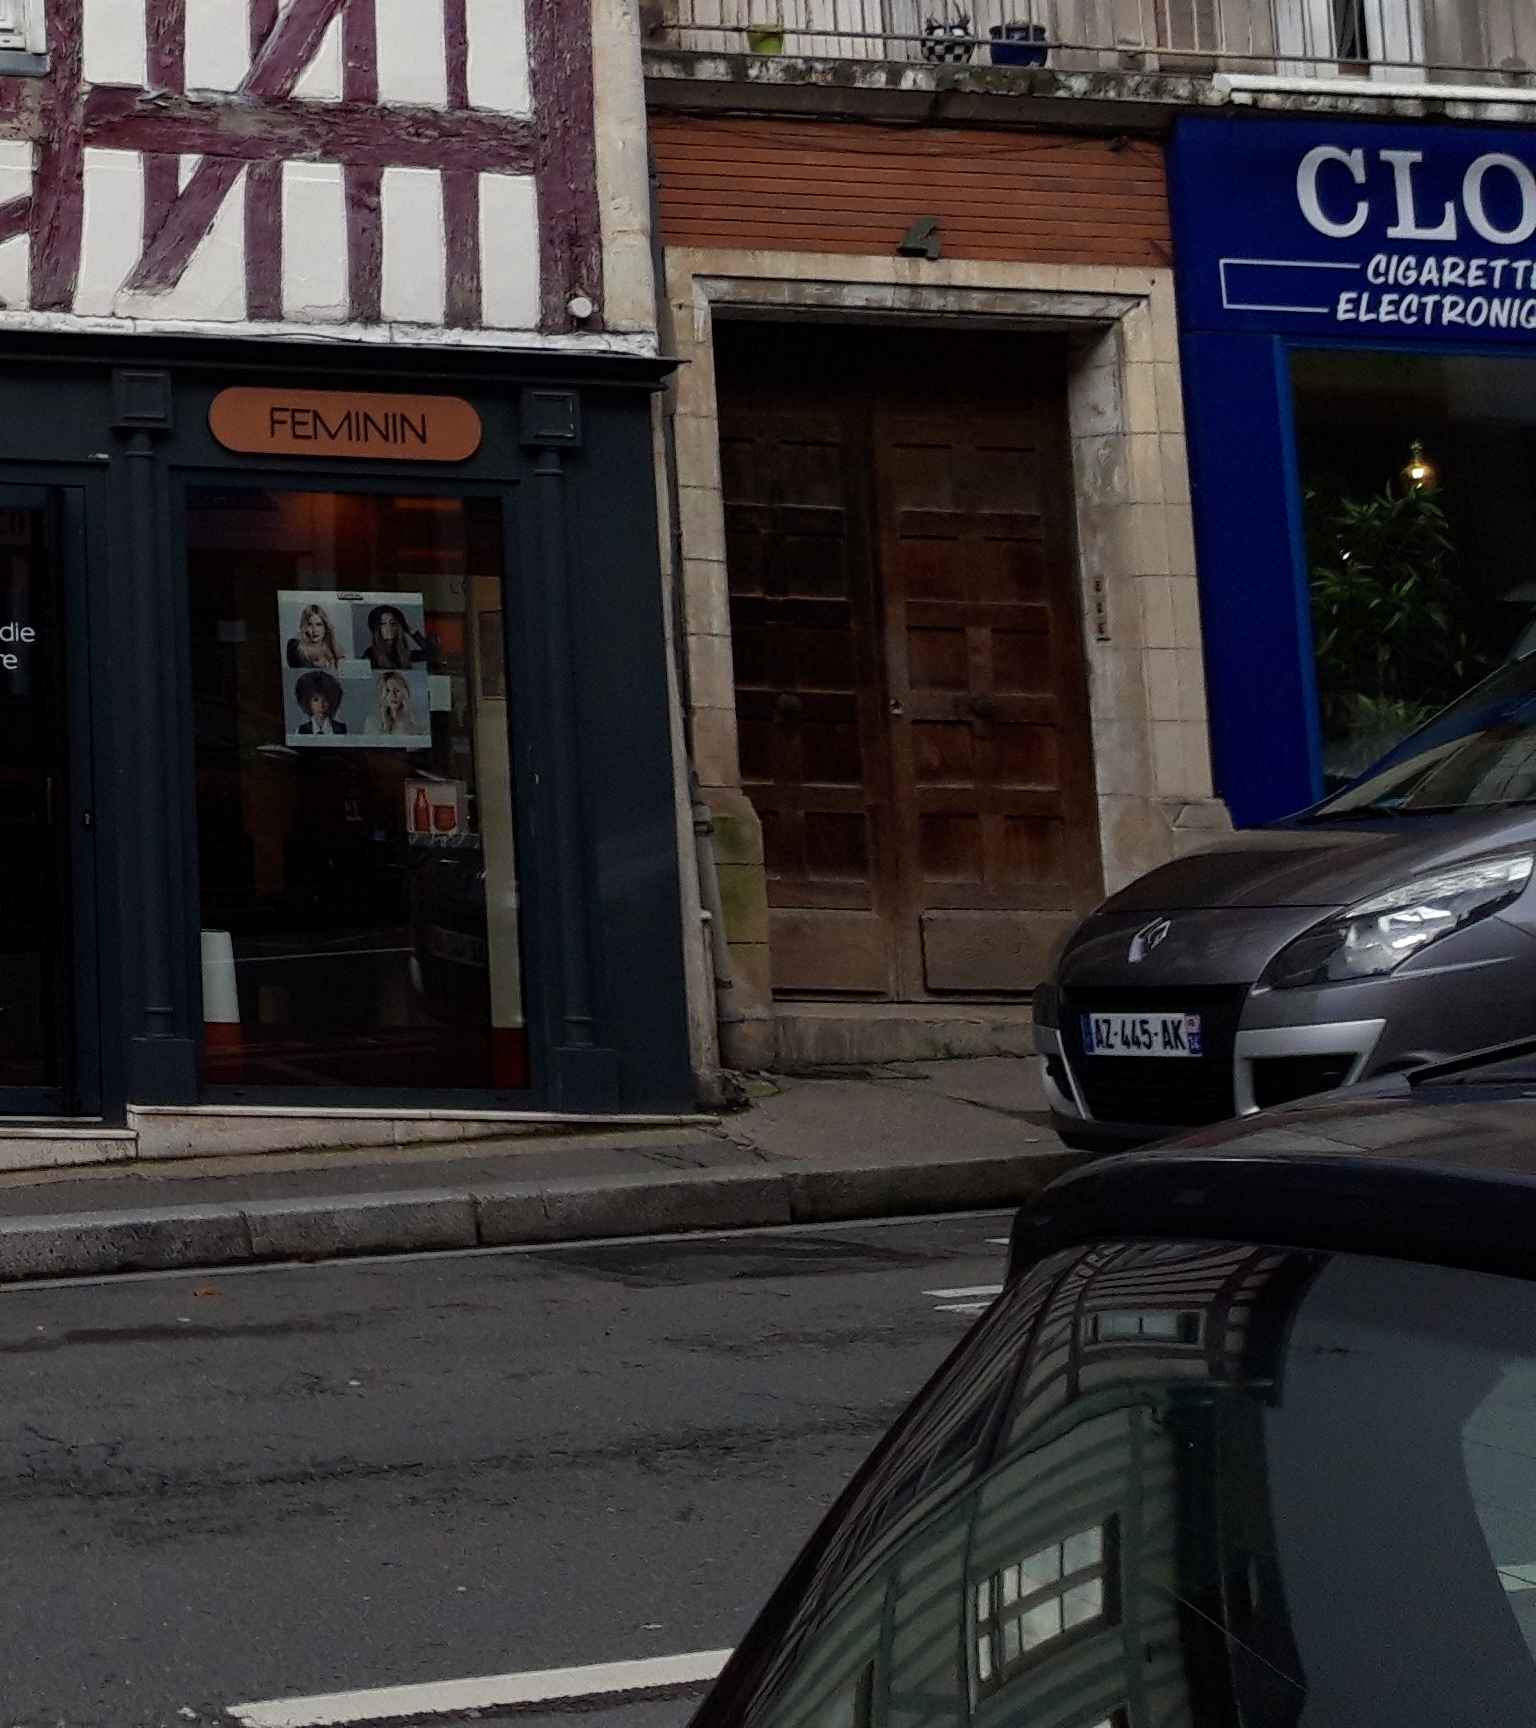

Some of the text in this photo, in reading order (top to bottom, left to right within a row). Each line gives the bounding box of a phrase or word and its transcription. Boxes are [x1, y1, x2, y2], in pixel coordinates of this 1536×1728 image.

[1296, 144, 1536, 245] CLO
[1366, 253, 1536, 290] CIGARETT
[269, 406, 427, 445] FEMININ
